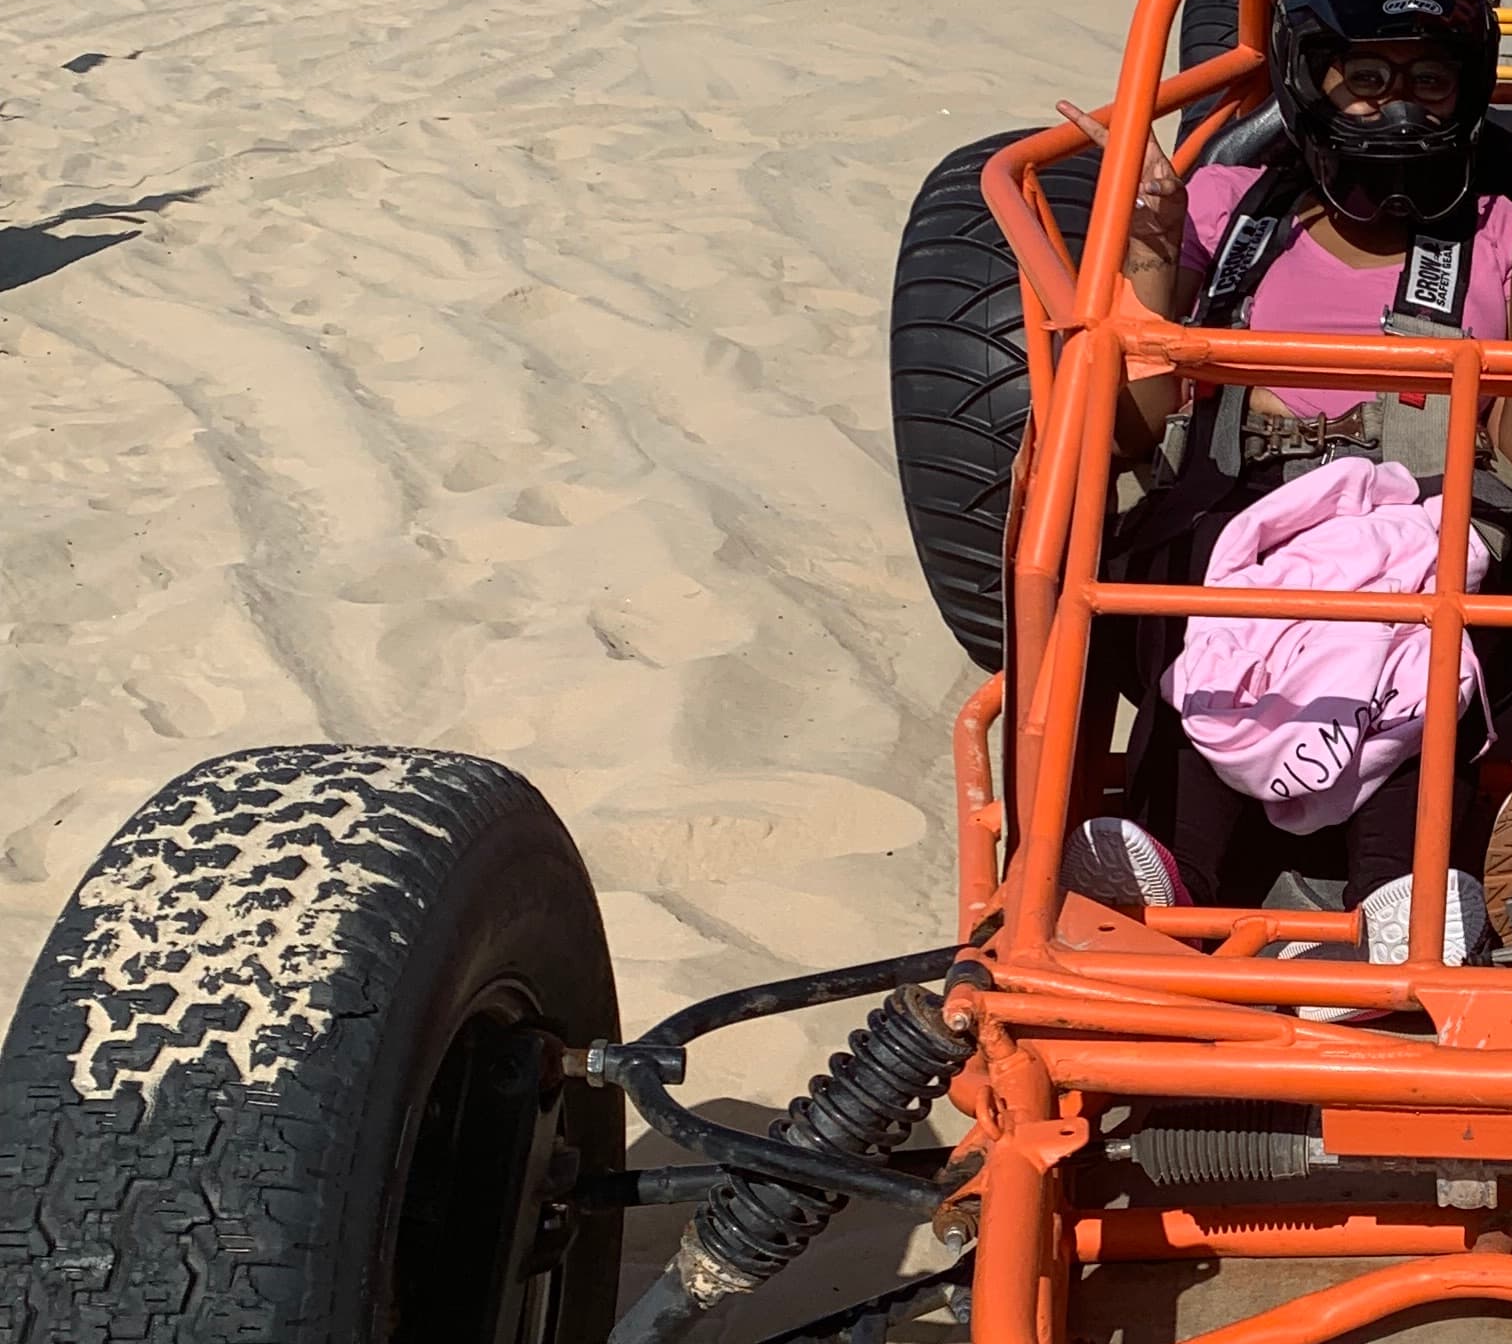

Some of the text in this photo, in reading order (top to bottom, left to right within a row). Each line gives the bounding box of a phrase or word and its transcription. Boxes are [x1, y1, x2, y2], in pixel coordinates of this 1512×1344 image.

[1414, 255, 1443, 303] CROW
[1437, 244, 1454, 307] SAFETY GEAR
